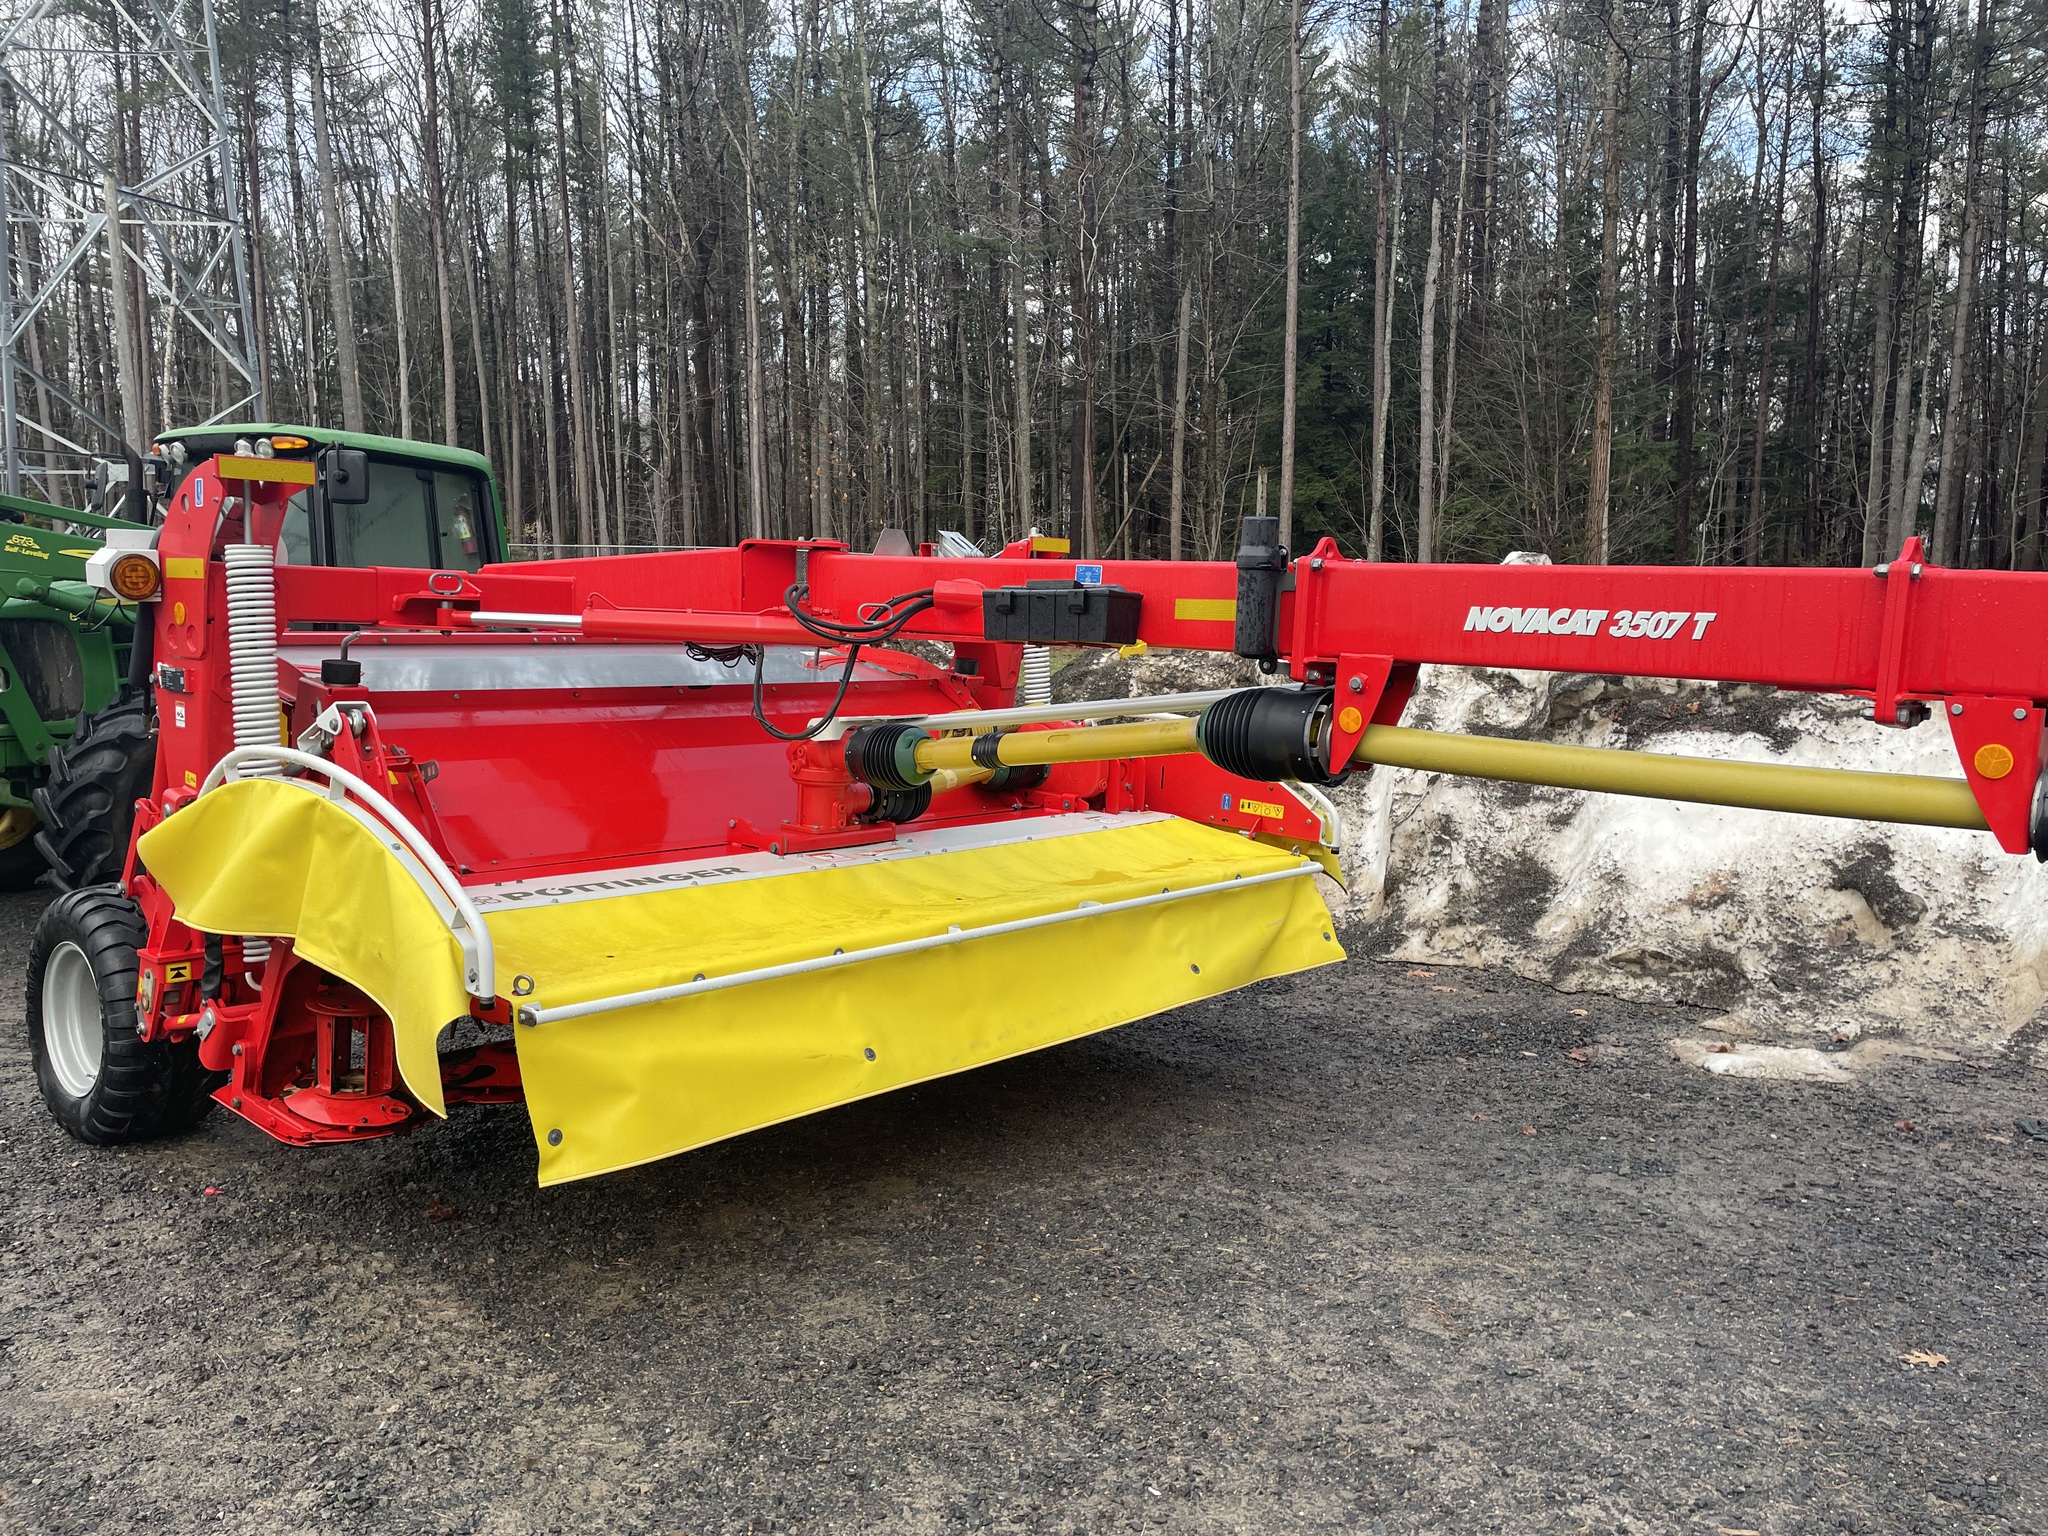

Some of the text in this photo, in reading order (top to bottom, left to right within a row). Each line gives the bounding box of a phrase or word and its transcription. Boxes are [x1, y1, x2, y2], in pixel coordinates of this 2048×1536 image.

[12, 534, 34, 546] 673
[1463, 606, 1717, 641] NOVACAT 3507 T
[498, 866, 749, 901] PÖTTINGER
